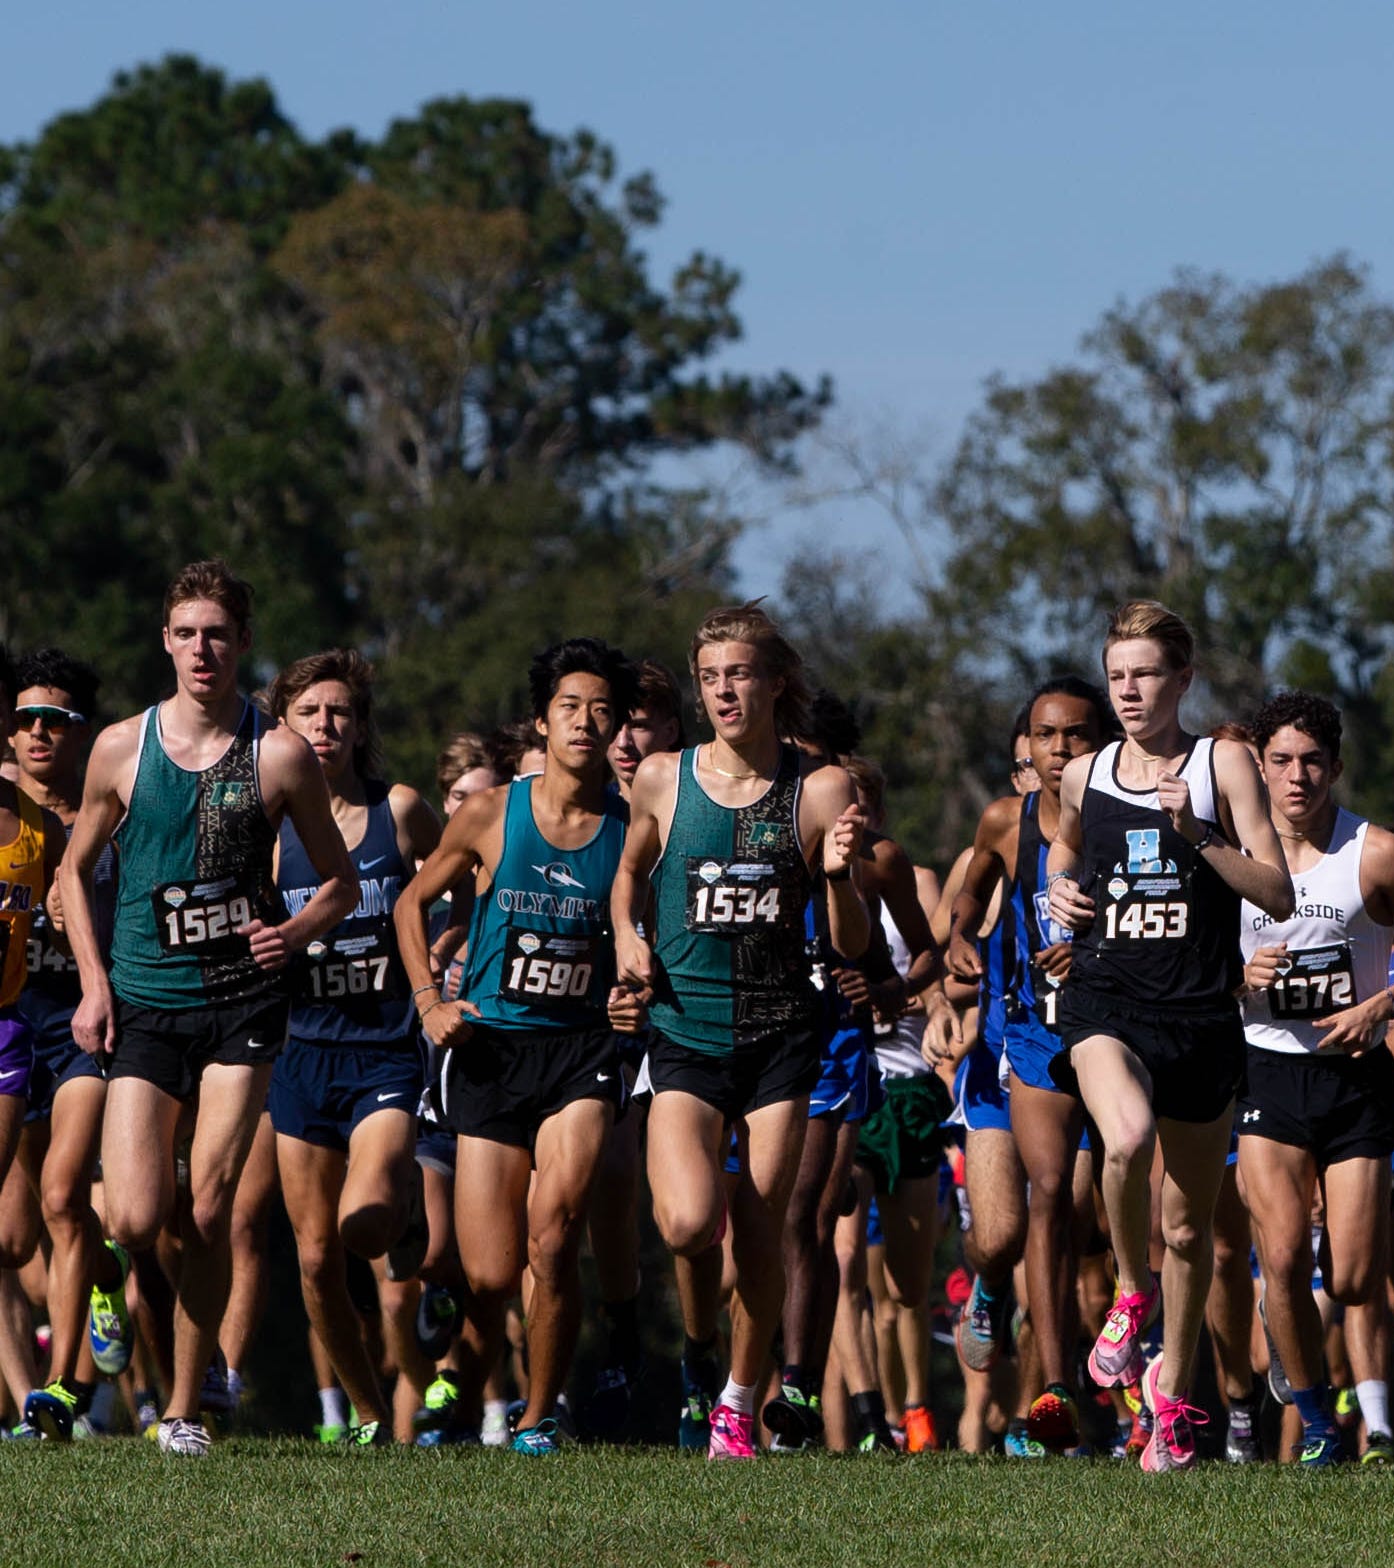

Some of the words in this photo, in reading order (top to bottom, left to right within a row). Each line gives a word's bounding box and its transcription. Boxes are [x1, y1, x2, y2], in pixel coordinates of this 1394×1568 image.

[165, 897, 251, 946] 1529
[695, 886, 780, 923] 1534
[1105, 902, 1188, 939] 1453
[1252, 904, 1345, 932] CRKSIDE
[310, 956, 389, 997] 1567
[508, 957, 592, 996] 1590
[1274, 971, 1353, 1011] 1372
